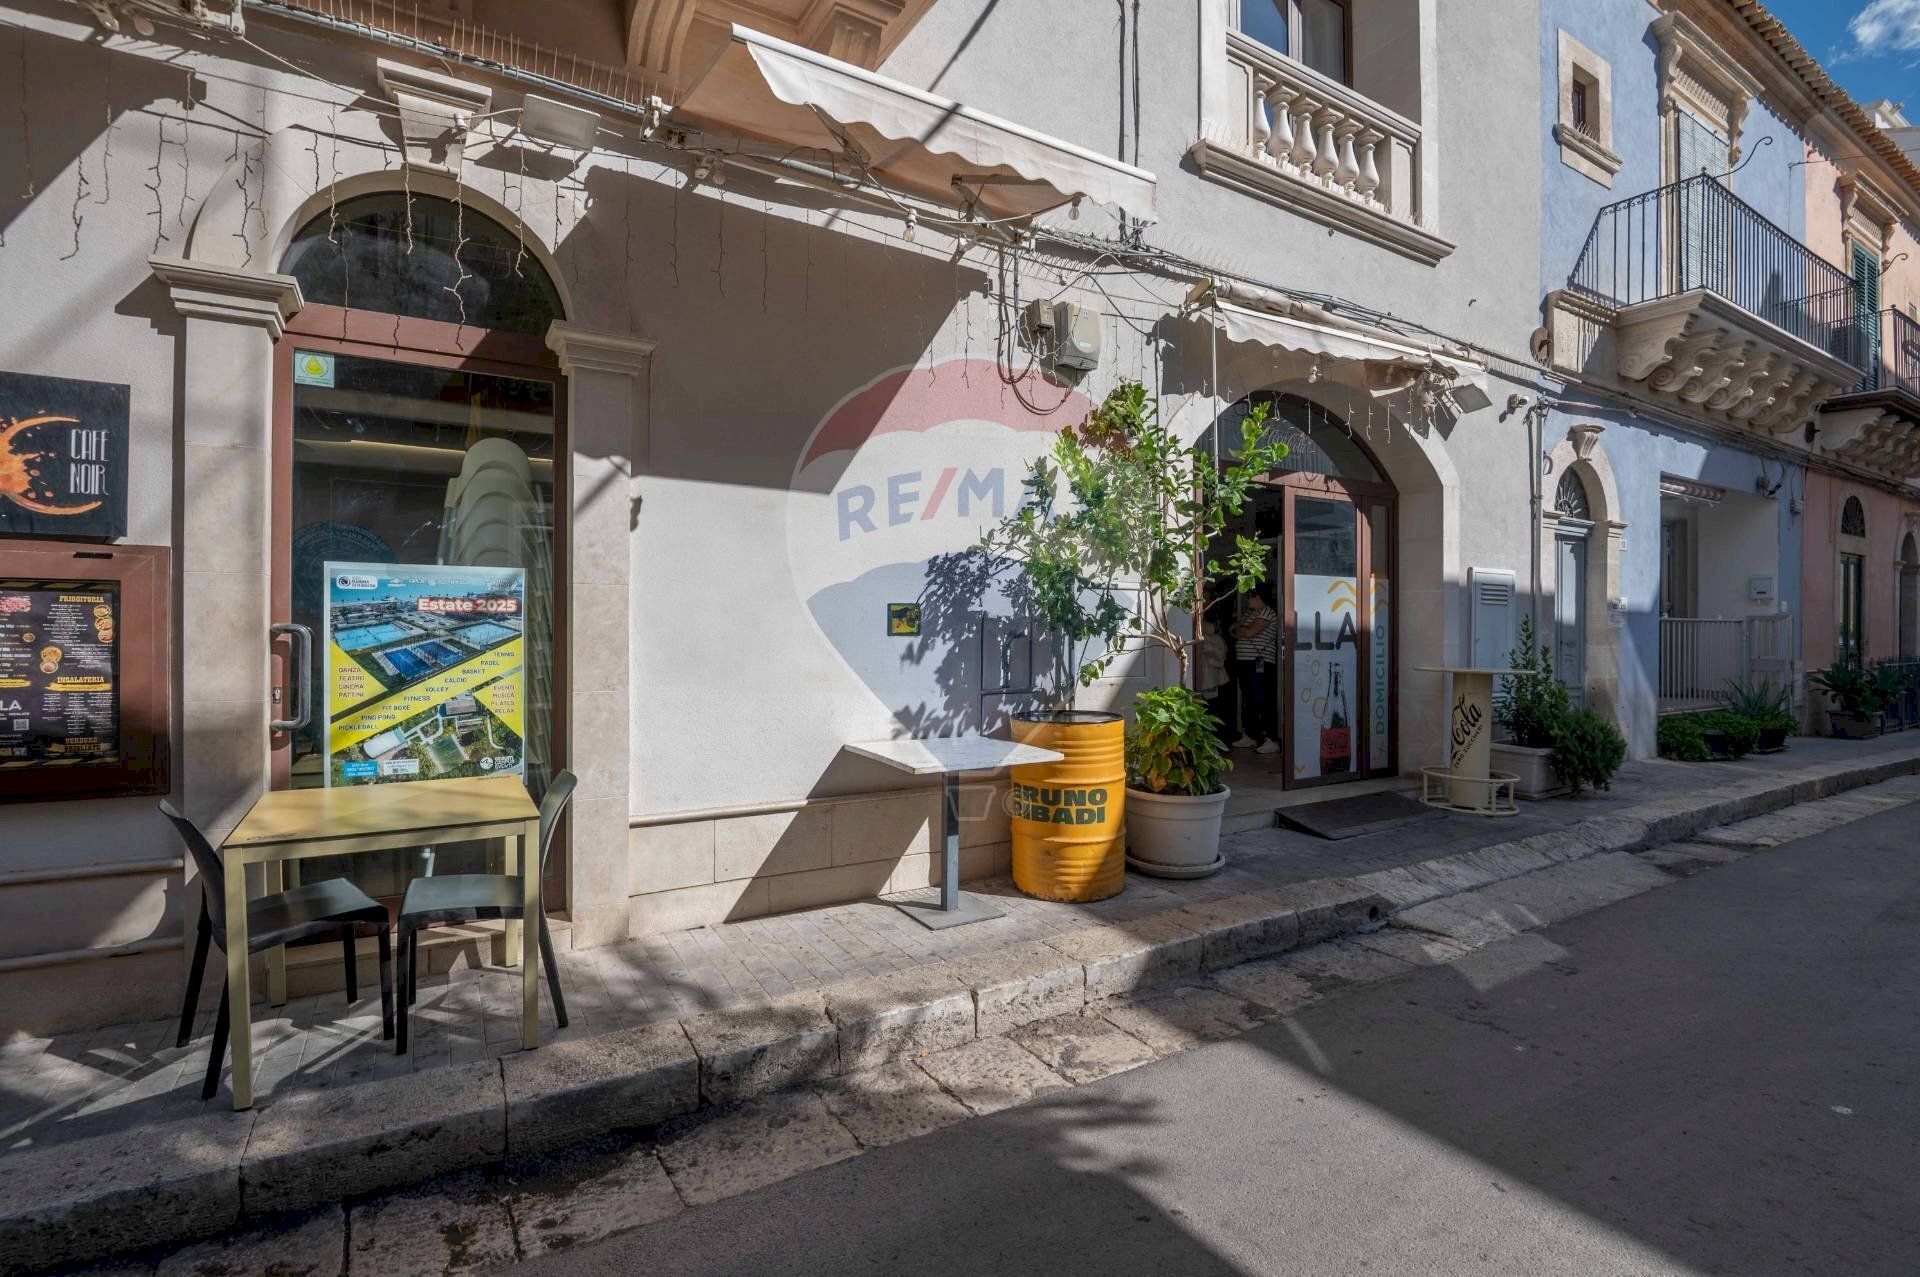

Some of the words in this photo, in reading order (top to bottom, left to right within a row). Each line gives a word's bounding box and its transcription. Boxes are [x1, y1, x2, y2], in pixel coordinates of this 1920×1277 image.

[70, 462, 110, 495] NOIR
[418, 598, 473, 611] Estate
[477, 599, 517, 612] 2025
[1375, 624, 1385, 735] DOMICILIO
